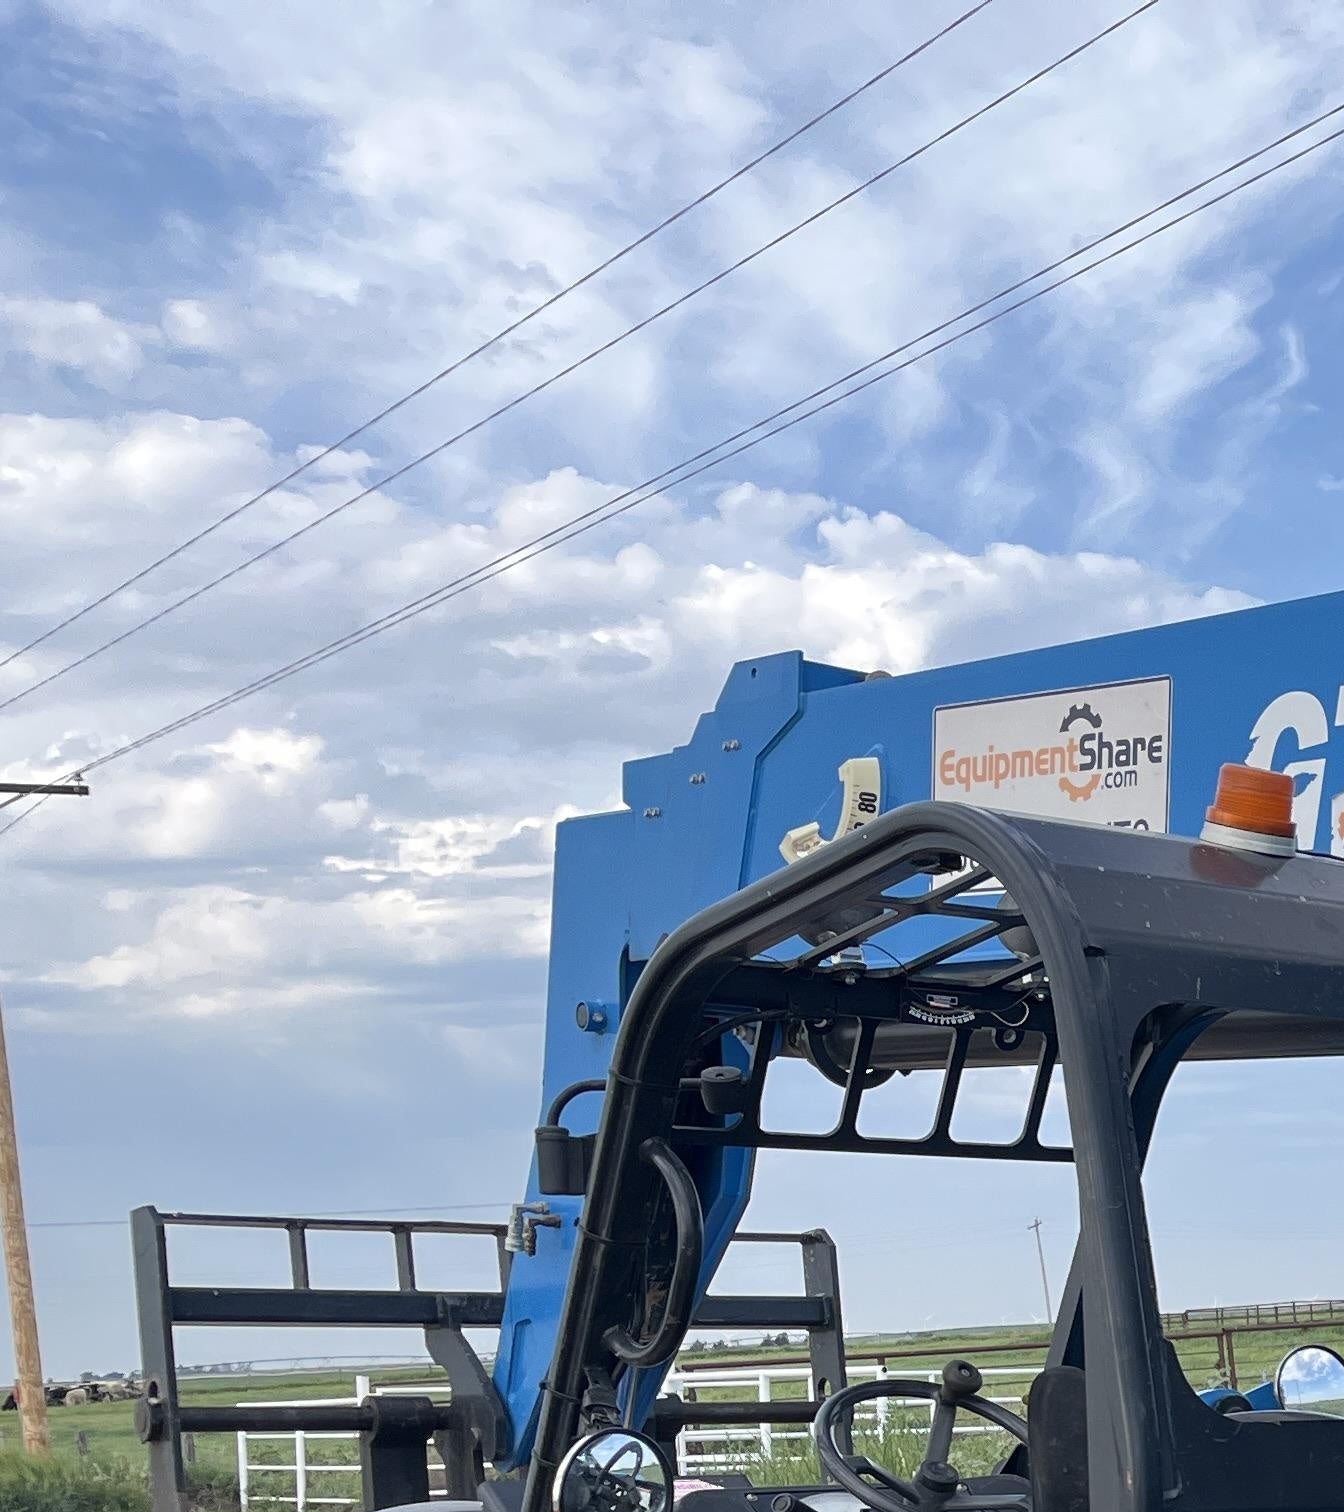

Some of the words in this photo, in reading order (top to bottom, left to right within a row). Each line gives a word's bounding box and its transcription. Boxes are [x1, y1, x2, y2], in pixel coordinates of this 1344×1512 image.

[940, 731, 1162, 792] EquipmentShare
[1102, 769, 1138, 789] .com
[858, 791, 877, 814] 80
